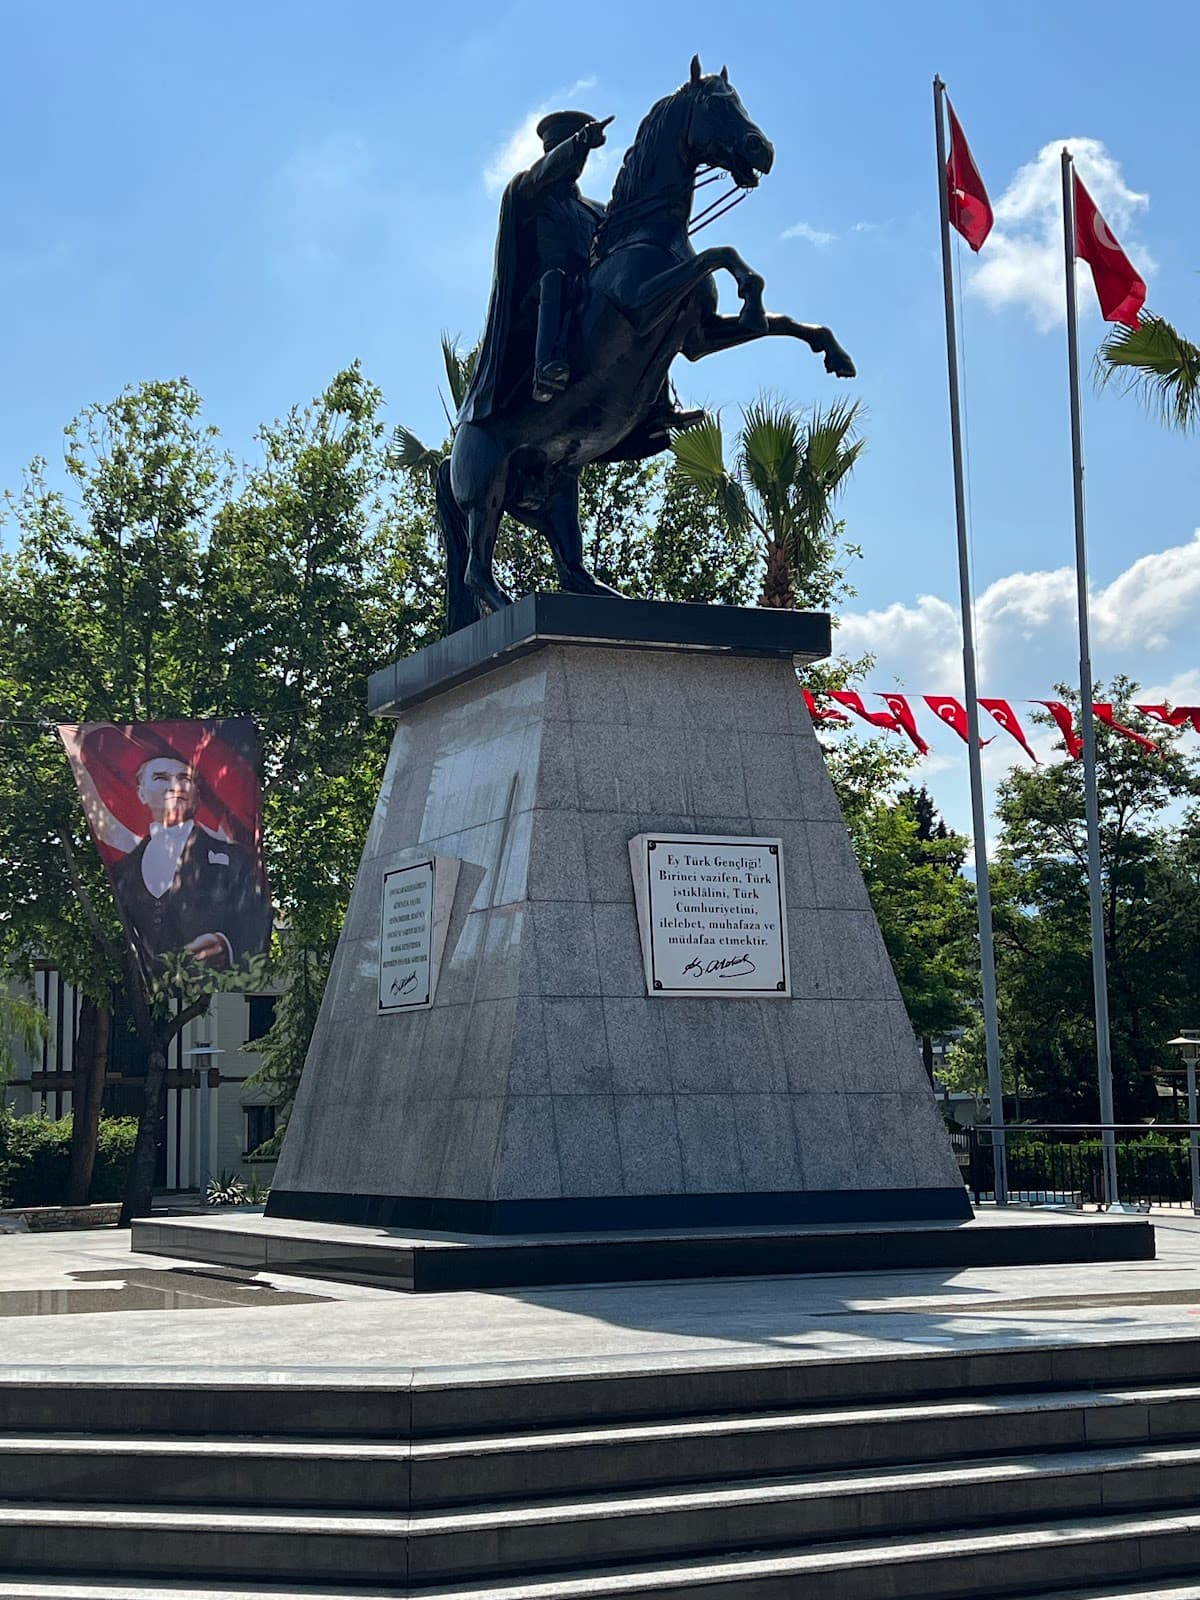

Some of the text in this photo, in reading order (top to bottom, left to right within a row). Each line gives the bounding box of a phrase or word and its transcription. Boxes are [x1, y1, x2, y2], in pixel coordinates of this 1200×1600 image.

[667, 854, 761, 871] Ey Türk Gençliği!
[659, 870, 772, 884] Birinci vazifen, Türk
[673, 886, 759, 899] istiklâlini, Türk
[676, 902, 758, 917] Cumhuriyetini,
[659, 917, 775, 930] ilelebet, muhafaza ve
[668, 933, 768, 946] müdafaa etmektir.
